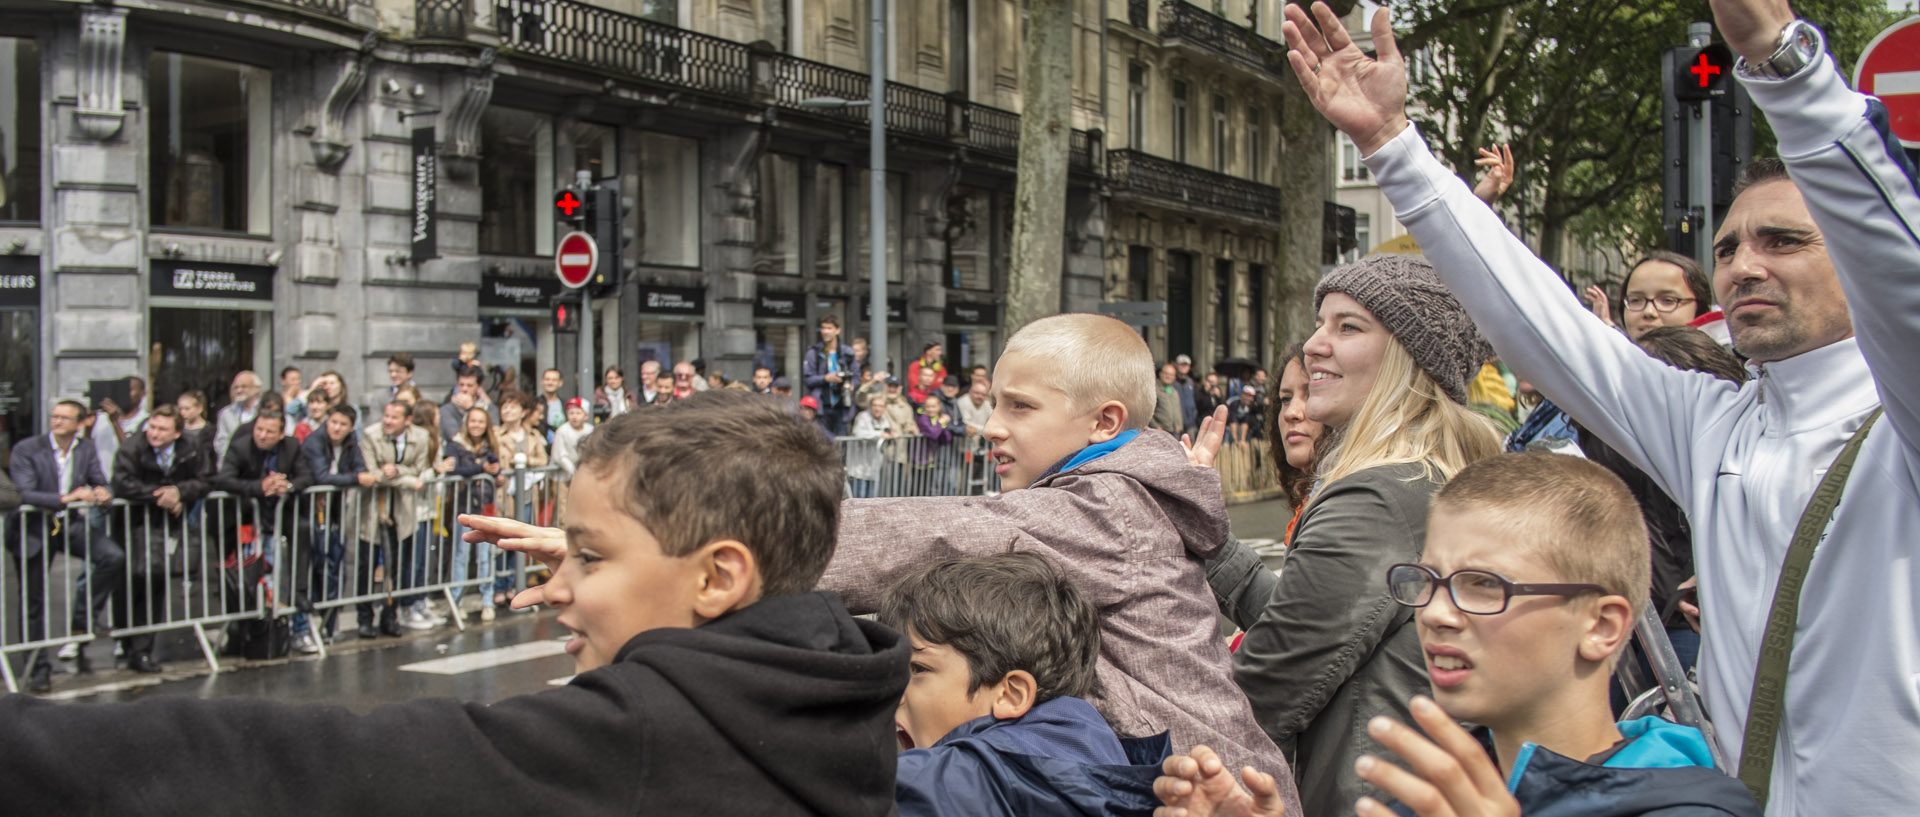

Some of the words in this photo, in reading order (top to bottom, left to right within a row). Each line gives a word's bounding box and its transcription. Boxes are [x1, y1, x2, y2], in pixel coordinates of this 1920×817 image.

[413, 154, 428, 242] Voyageurs
[194, 278, 255, 292] D'AVENTURE
[195, 269, 235, 282] TERRES
[1795, 462, 1851, 549] CONVERSE
[1764, 564, 1802, 661] CONVERSE
[1746, 676, 1779, 769] CONVERSE
